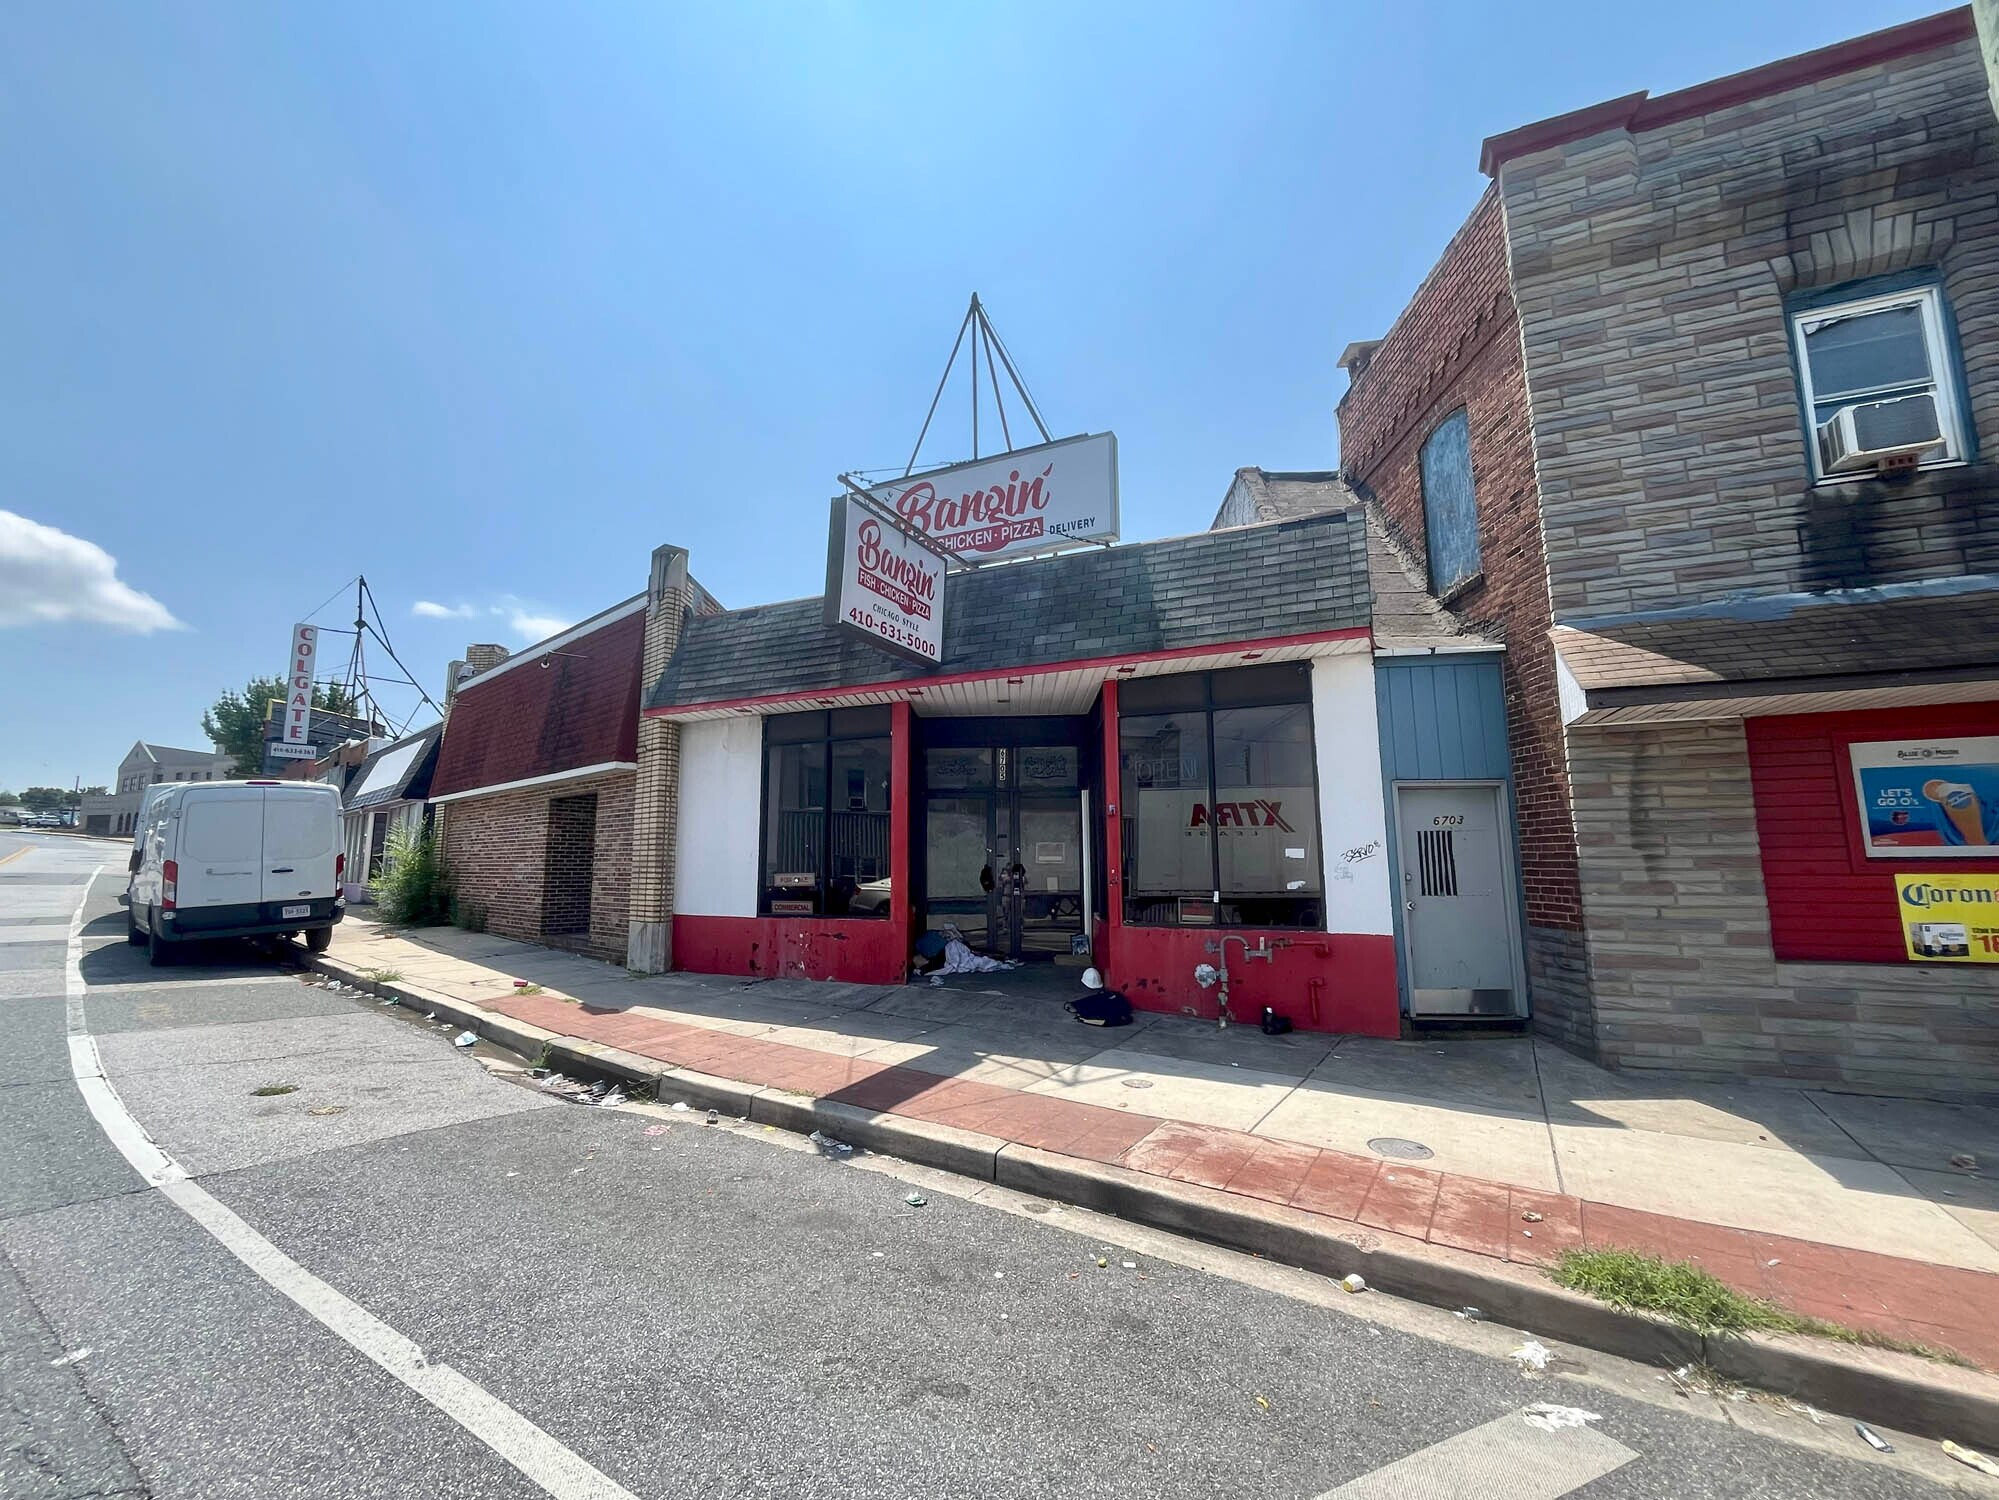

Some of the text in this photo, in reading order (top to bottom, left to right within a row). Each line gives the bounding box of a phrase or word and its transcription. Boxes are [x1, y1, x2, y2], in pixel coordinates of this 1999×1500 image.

[1001, 521, 1041, 541] PIZZA
[1050, 517, 1096, 535] DELIVERY
[858, 519, 939, 600] Bangin'
[860, 571, 931, 619] FISH CHICKEN PIZZA
[872, 603, 919, 632] CHICAGO STYLE
[849, 607, 936, 656] 410-631-5000
[290, 627, 314, 739] COLGATE
[1138, 759, 1198, 780] OPEN
[1877, 798, 1897, 806] GO
[1880, 788, 1913, 797] LET'S
[1433, 815, 1464, 825] 6703
[1902, 883, 1999, 909] Coron
